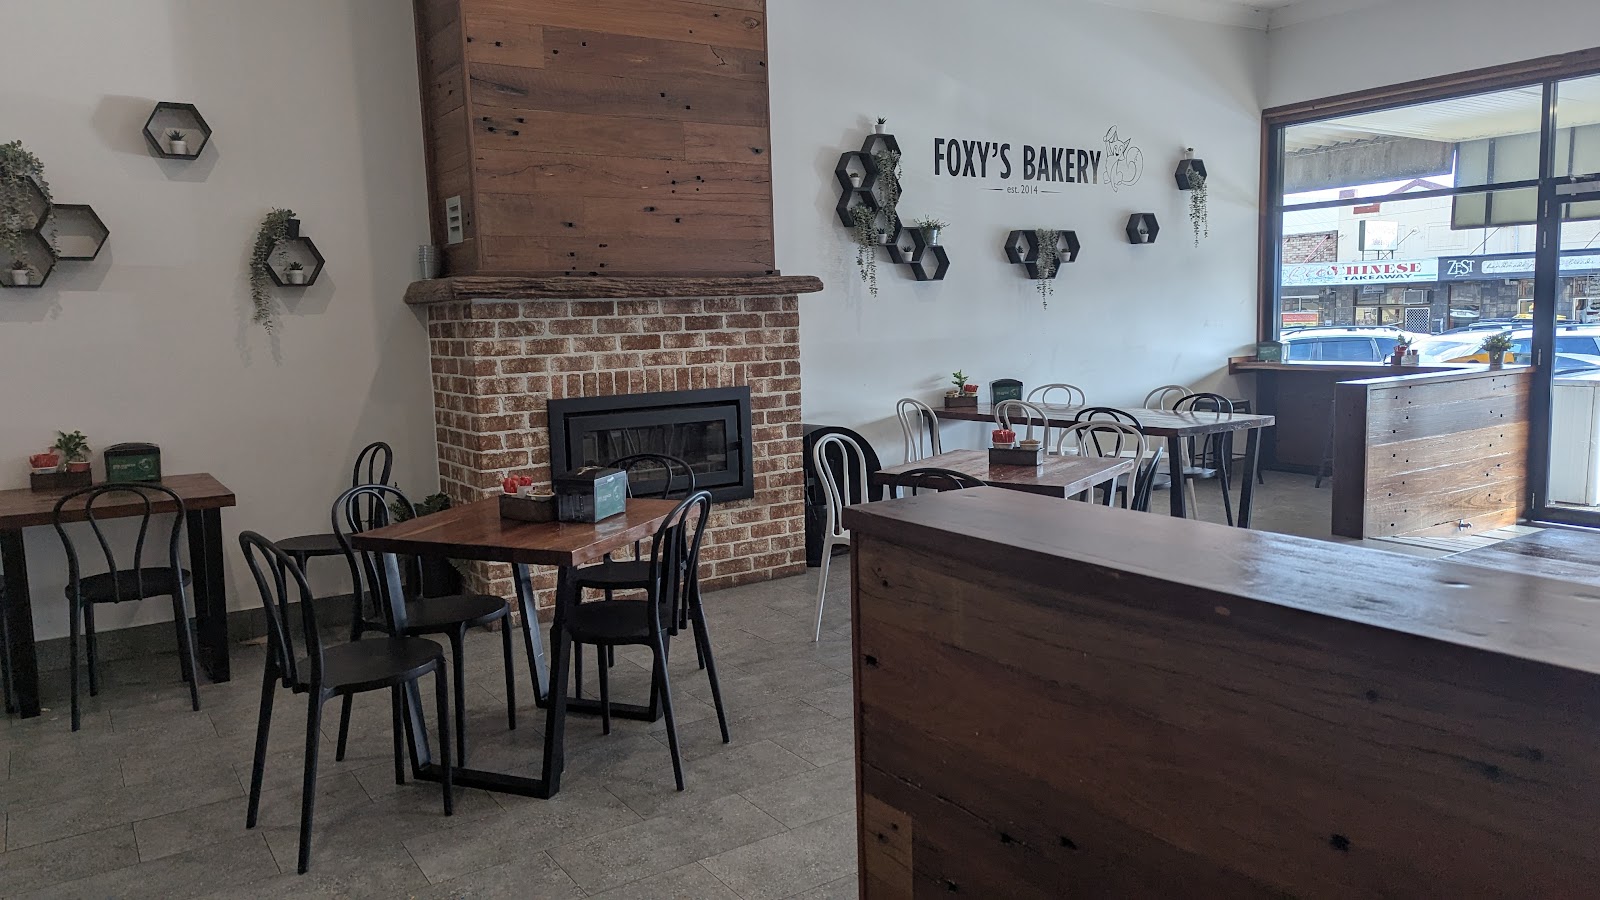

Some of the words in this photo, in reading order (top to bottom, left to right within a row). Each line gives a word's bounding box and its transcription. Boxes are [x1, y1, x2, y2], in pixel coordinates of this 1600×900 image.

[934, 137, 1012, 180] FOXY'S
[1023, 144, 1102, 185] BAKERY
[1006, 186, 1019, 194] est.
[1020, 185, 1038, 195] 2014
[1447, 259, 1475, 275] ZEST
[1343, 273, 1413, 281] TAKEAWAY
